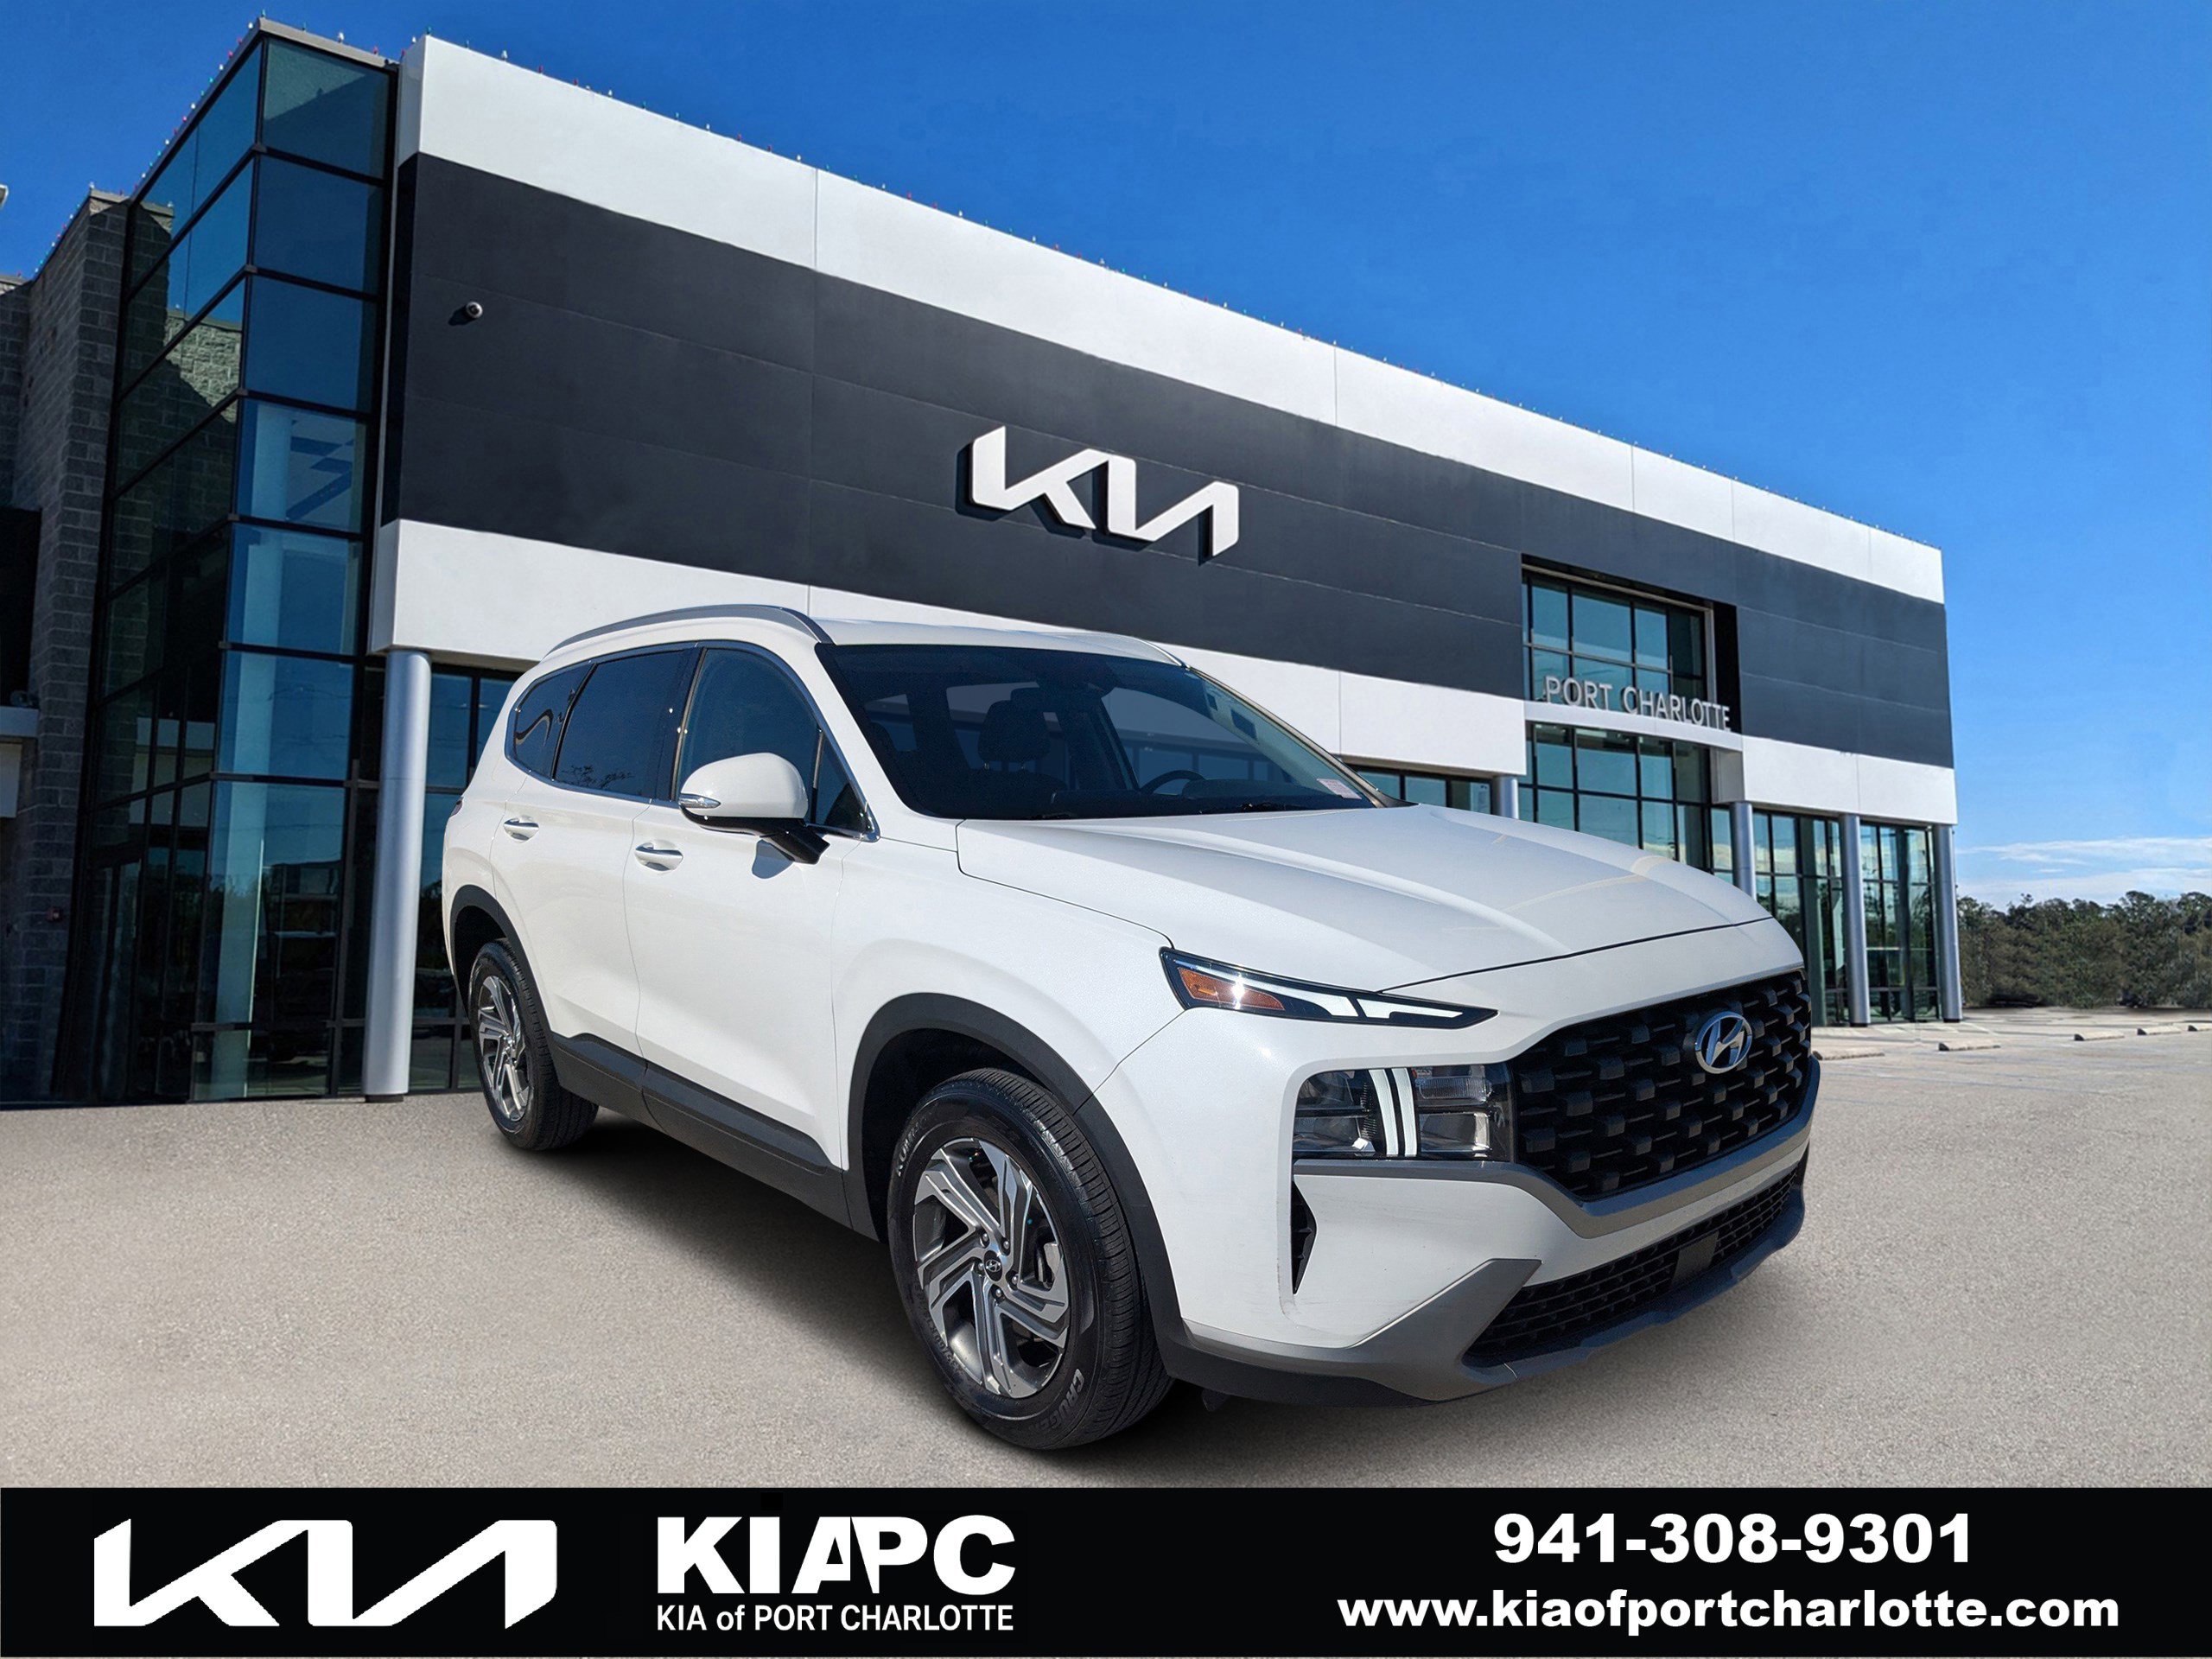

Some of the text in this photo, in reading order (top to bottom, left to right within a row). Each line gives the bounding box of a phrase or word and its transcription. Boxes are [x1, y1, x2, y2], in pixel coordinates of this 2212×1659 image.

[972, 425, 1239, 556] KIA
[1544, 676, 1732, 733] PORT CHARLOTTE
